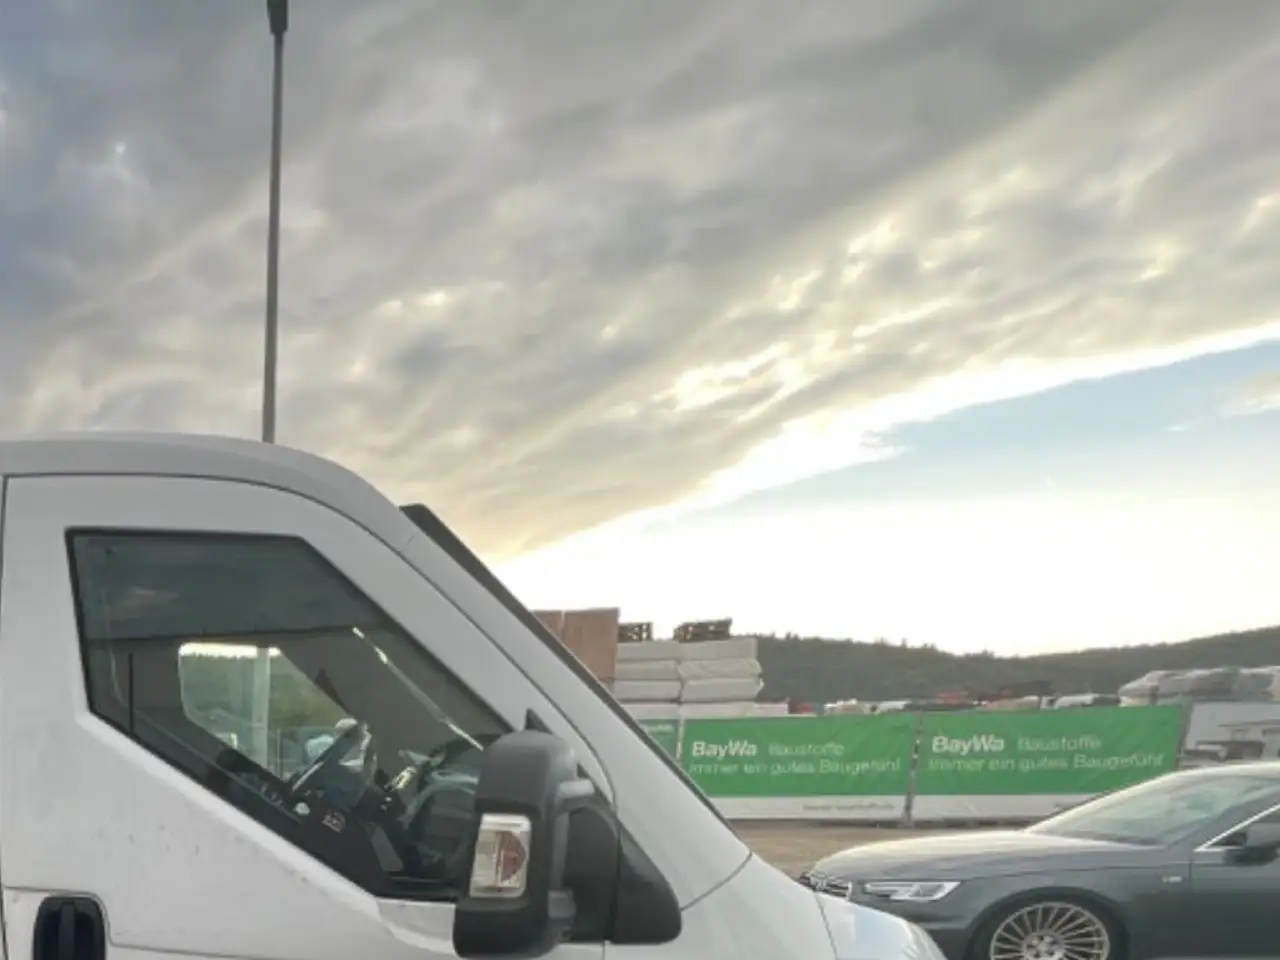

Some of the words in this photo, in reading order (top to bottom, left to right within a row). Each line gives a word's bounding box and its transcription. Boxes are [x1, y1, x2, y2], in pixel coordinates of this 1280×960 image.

[691, 740, 758, 762] BayWa
[768, 742, 846, 756] Baustoffe
[931, 734, 1005, 756] BayWa
[1017, 734, 1102, 751] Baustoffe
[988, 757, 1015, 771] ein
